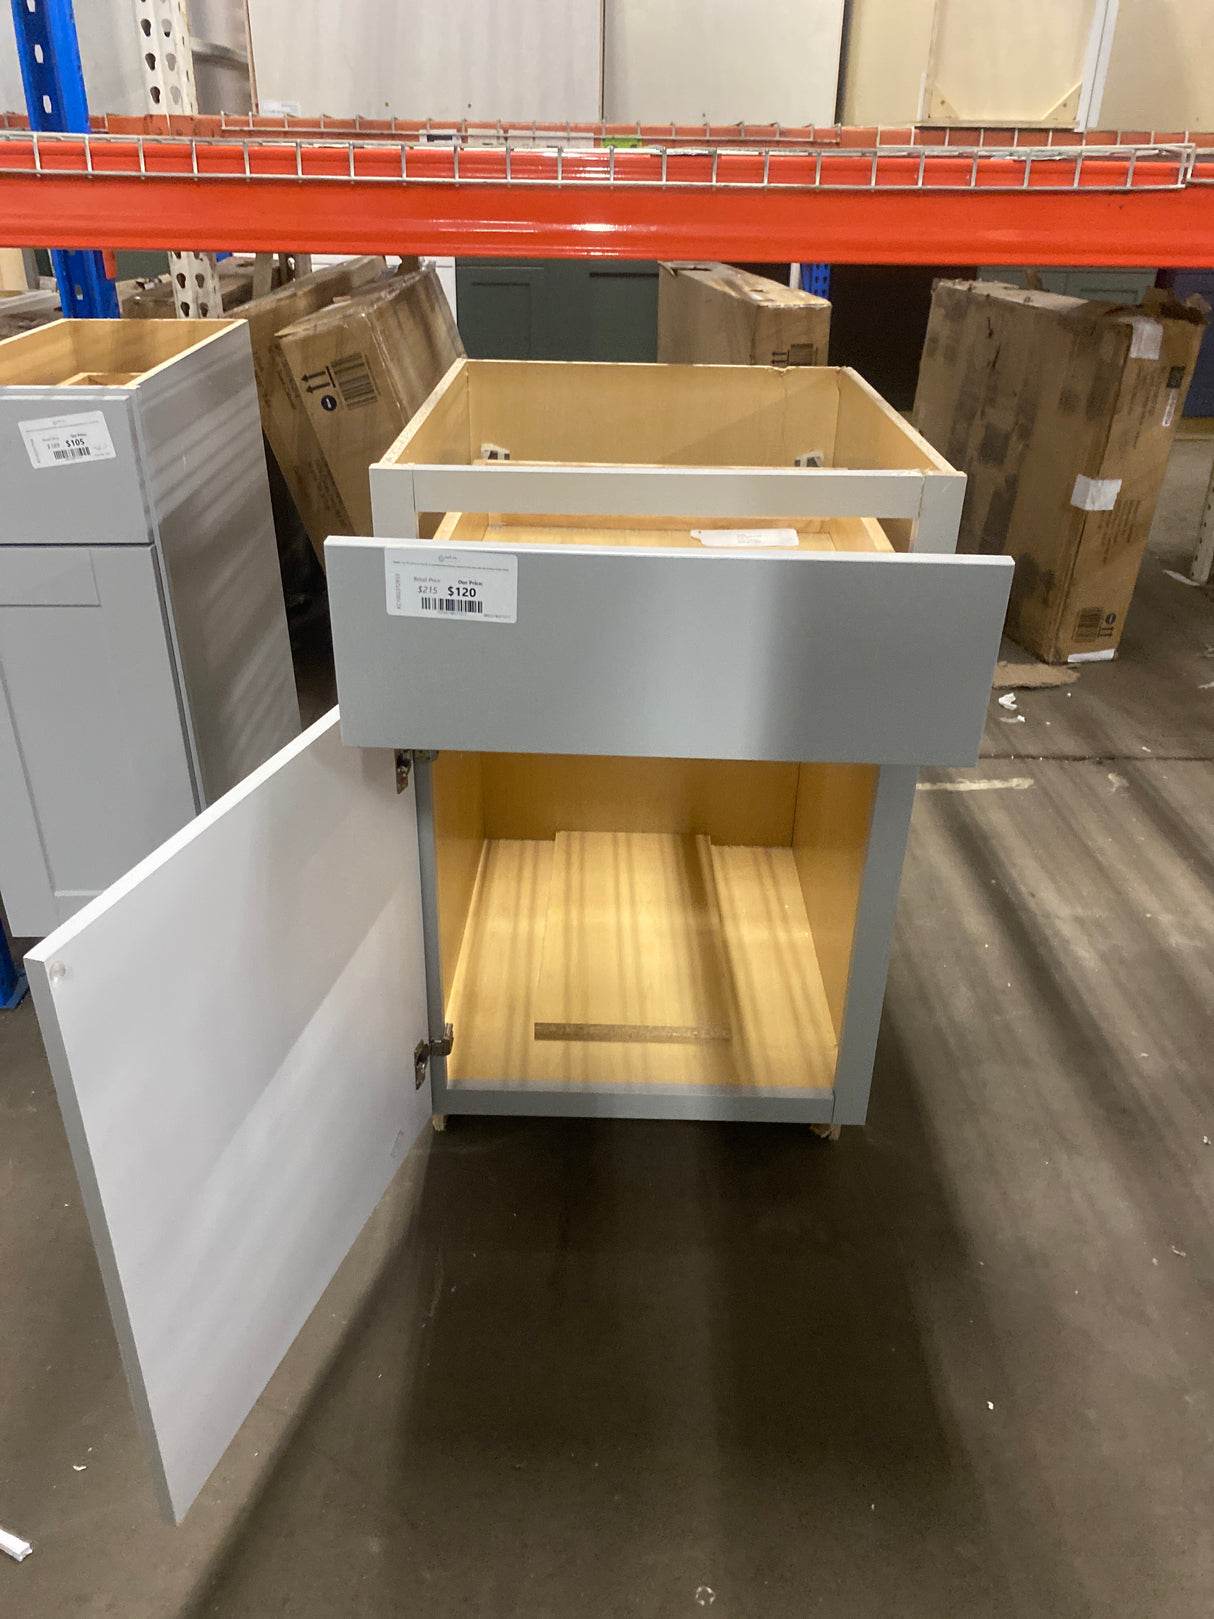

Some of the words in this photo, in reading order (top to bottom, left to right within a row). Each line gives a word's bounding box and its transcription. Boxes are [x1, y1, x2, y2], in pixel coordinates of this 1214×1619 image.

[66, 438, 84, 448] $105
[418, 586, 438, 594] $215
[448, 586, 476, 598] $120
